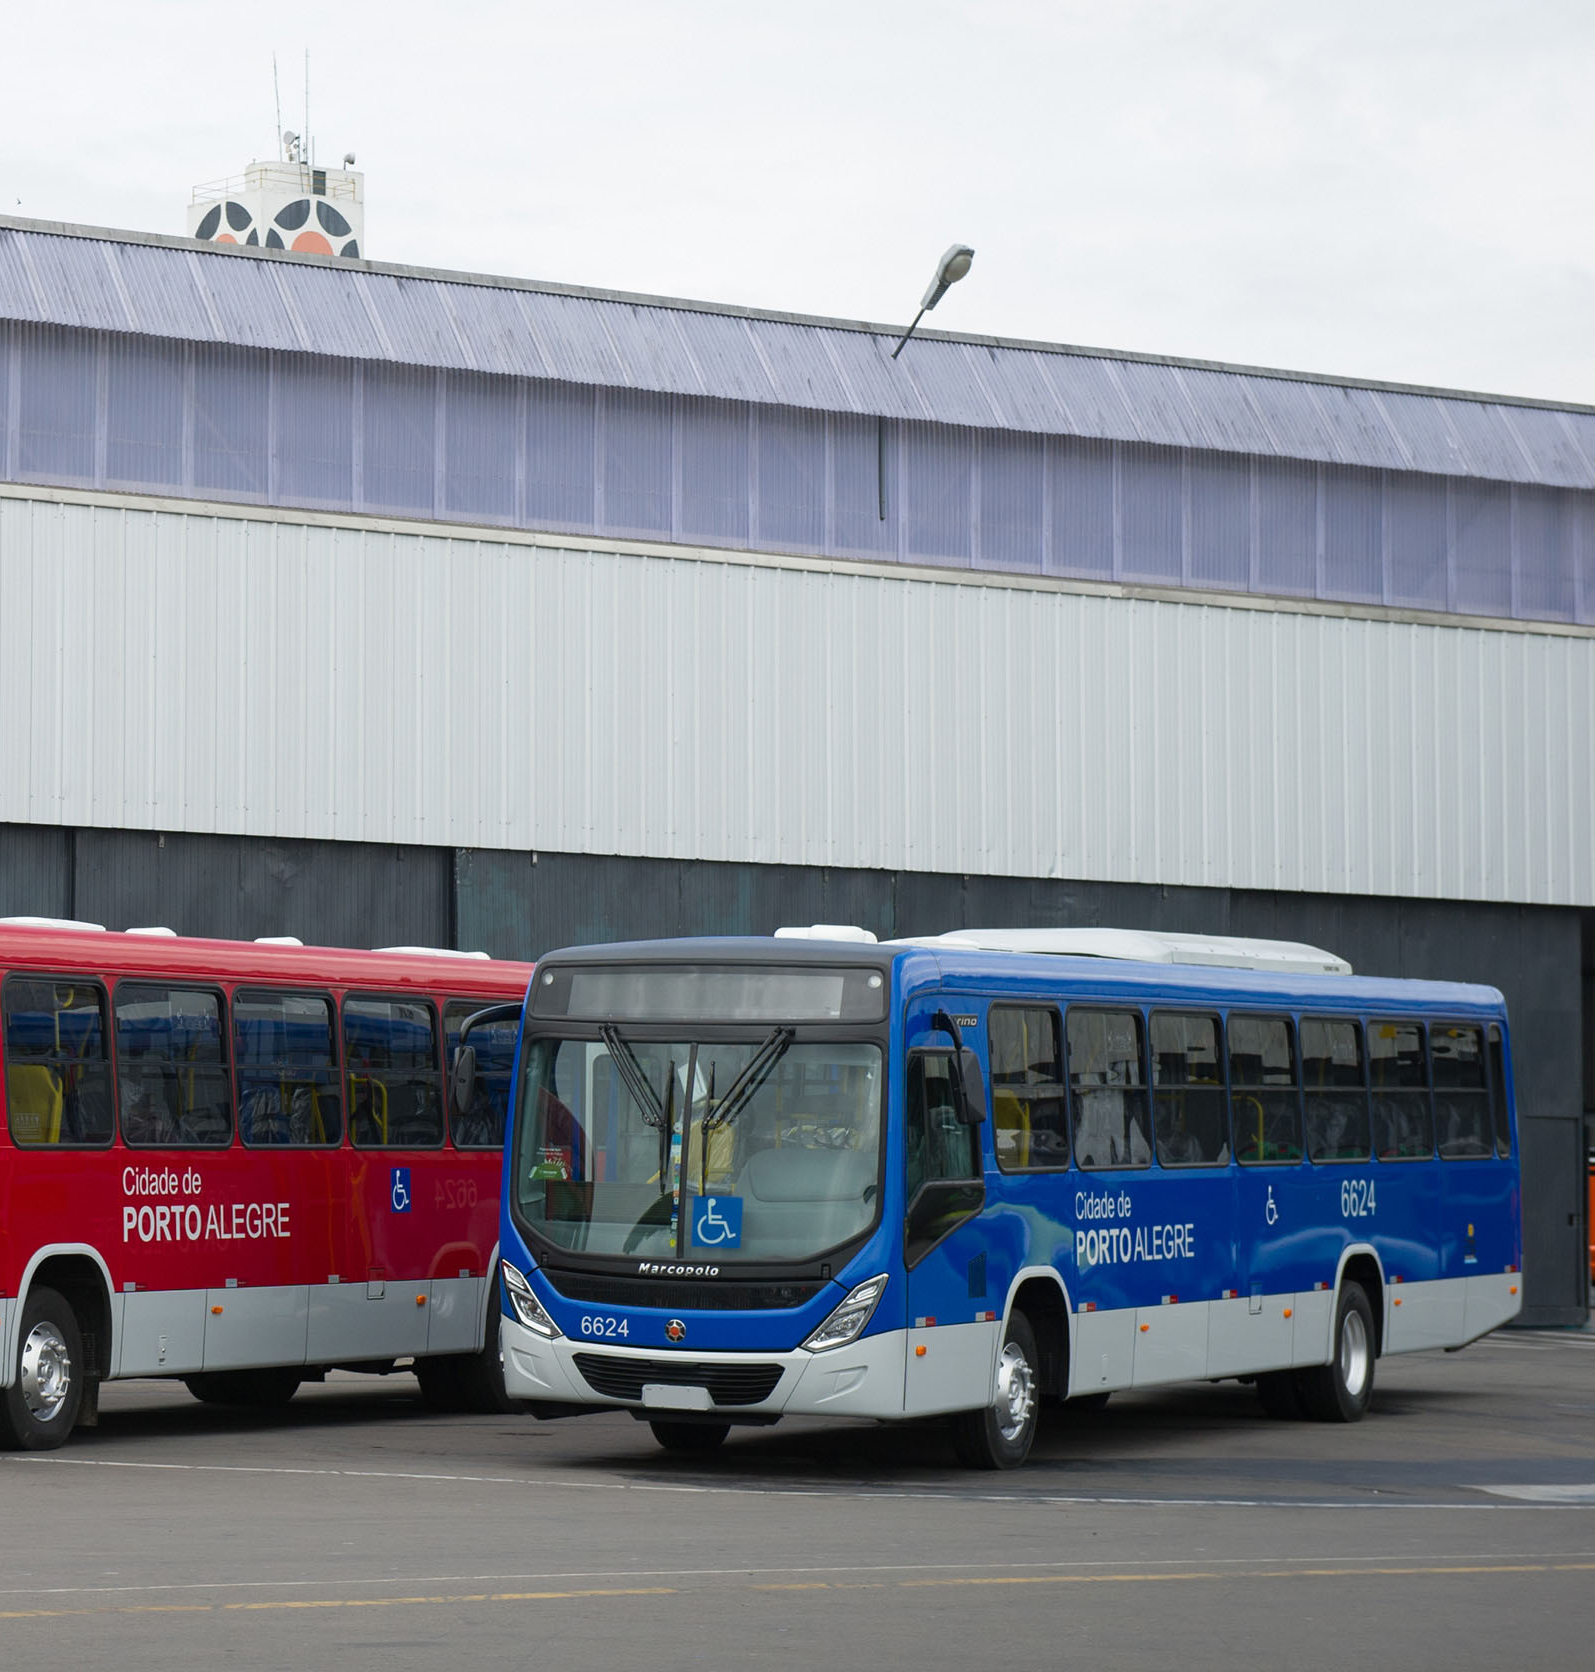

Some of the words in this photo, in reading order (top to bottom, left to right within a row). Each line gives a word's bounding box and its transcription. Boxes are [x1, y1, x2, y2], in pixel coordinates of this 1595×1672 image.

[956, 1016, 977, 1026] rino
[122, 1166, 179, 1196] Cidade
[182, 1166, 202, 1194] de
[1075, 1190, 1115, 1220] Cidade
[1117, 1190, 1132, 1218] de
[1341, 1179, 1376, 1217] 6624
[123, 1204, 202, 1242] PORTO
[205, 1203, 291, 1240] ALEGRE
[1076, 1227, 1132, 1267] PORTO
[1134, 1223, 1195, 1262] ALEGRE
[638, 1263, 719, 1276] Marcopolo
[581, 1315, 629, 1337] 6624
